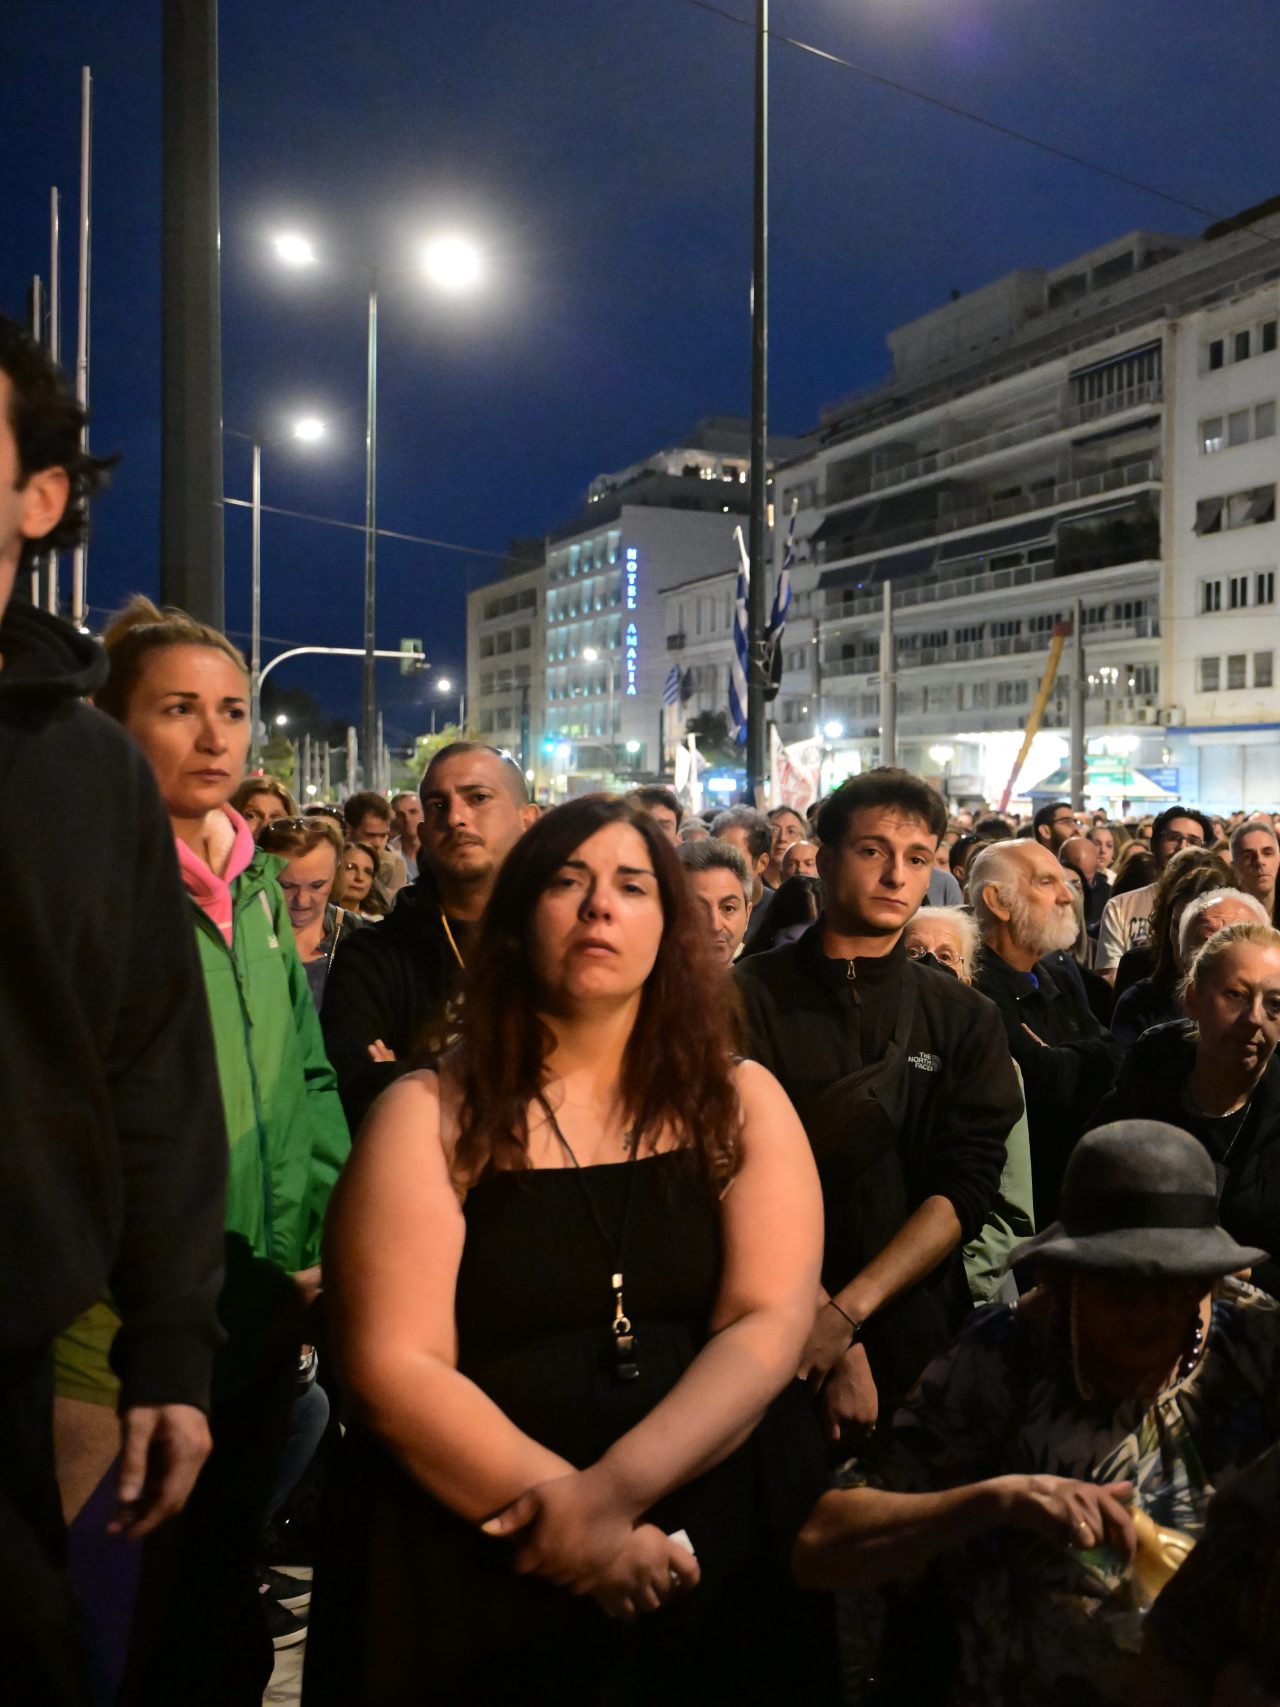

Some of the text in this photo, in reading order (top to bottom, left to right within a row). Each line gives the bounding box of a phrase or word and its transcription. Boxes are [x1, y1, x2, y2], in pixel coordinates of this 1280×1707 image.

[626, 548, 637, 695] HOTEL AMALIA
[919, 1051, 932, 1060] THE
[907, 1056, 932, 1065] NORTH
[914, 1062, 932, 1072] FACE
